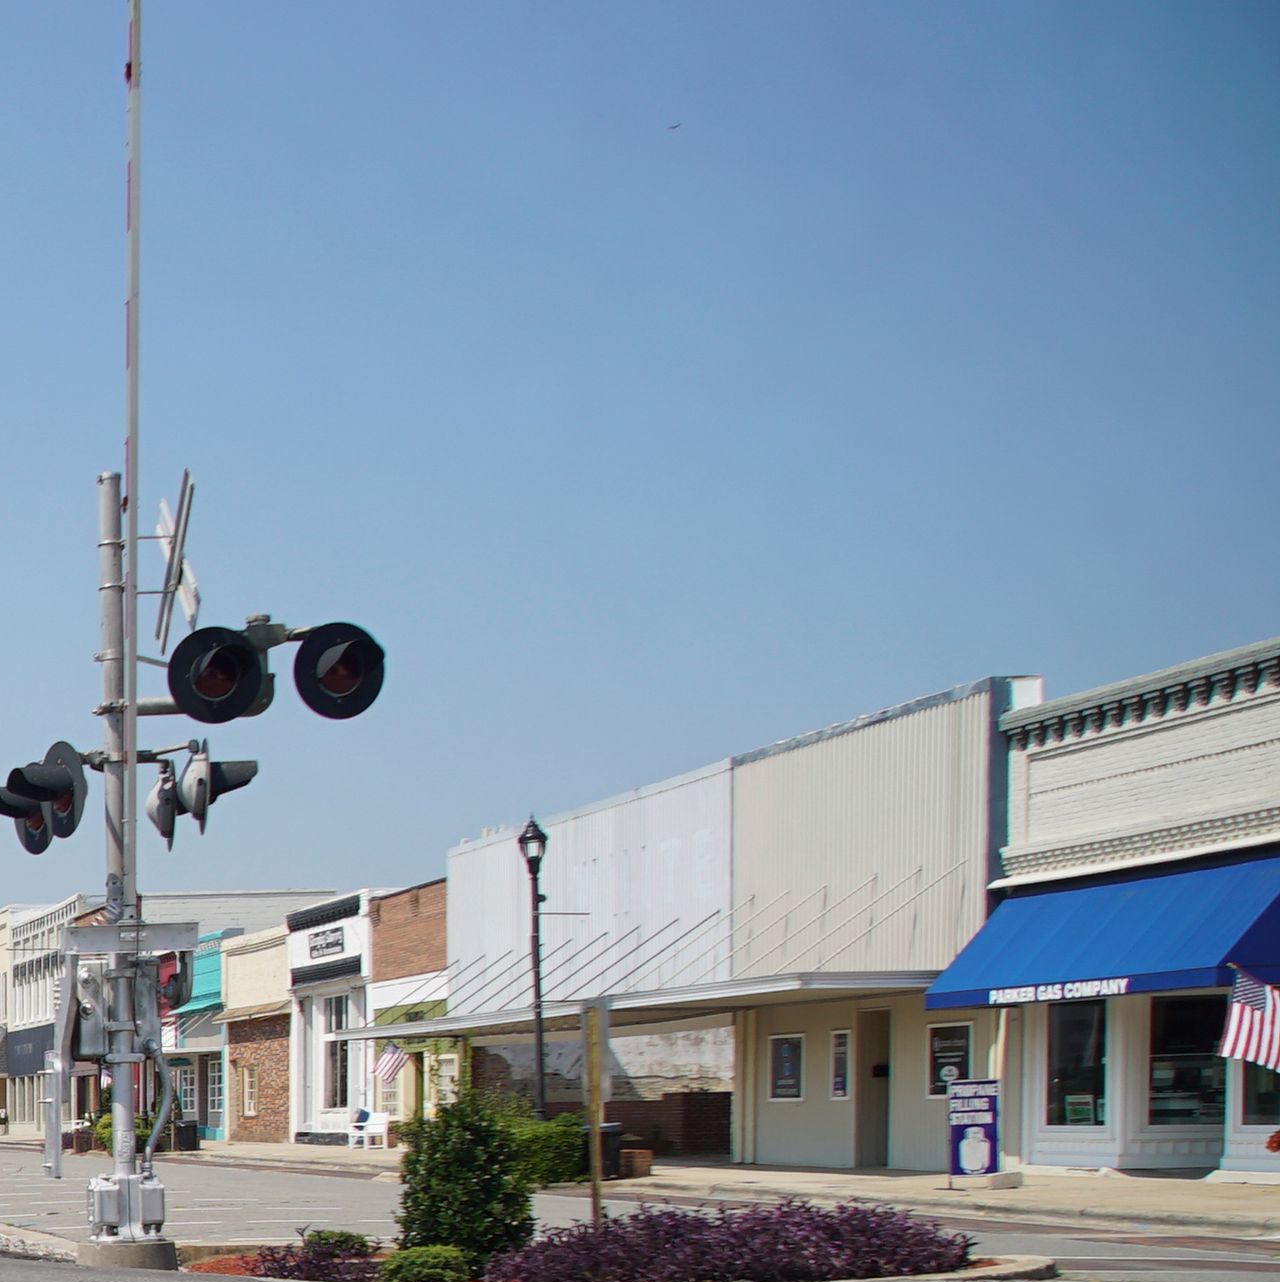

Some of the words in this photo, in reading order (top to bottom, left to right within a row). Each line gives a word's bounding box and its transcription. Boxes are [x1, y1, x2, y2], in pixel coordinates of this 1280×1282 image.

[989, 987, 1036, 1004] PARKER
[1037, 984, 1062, 1001] GAS
[1064, 978, 1128, 999] COMPANY
[950, 1084, 999, 1098] PROPANE
[949, 1098, 990, 1111] FILLING
